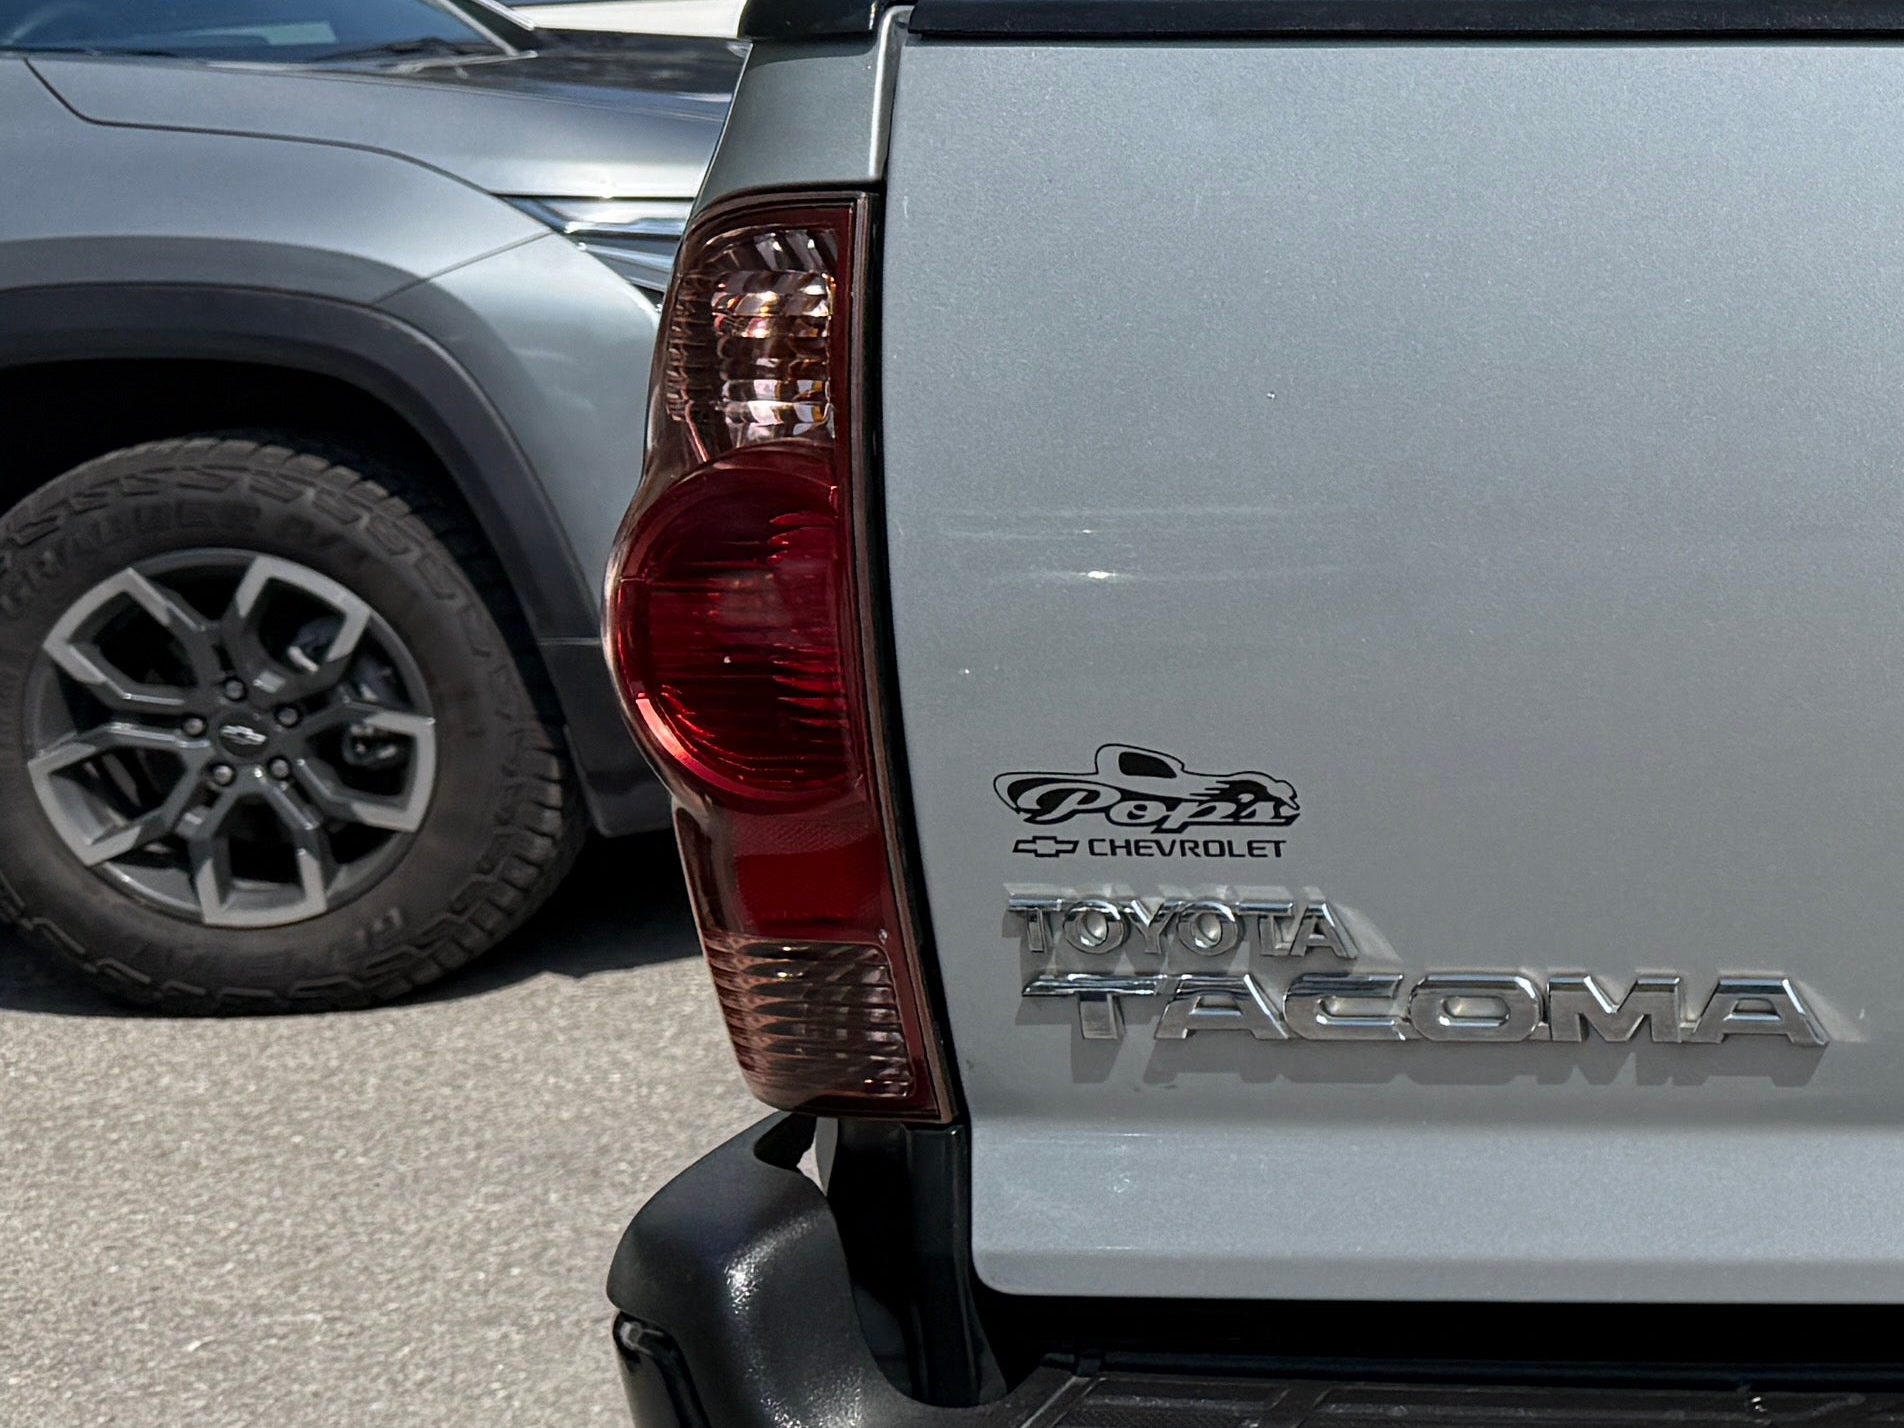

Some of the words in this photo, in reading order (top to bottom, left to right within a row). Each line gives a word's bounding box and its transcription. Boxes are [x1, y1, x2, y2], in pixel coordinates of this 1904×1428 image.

[1016, 781, 1292, 831] Pop's
[1087, 837, 1288, 858] CHEVROLET
[1006, 891, 1359, 960] TOYOTA
[1021, 973, 1830, 1046] TACOMA
